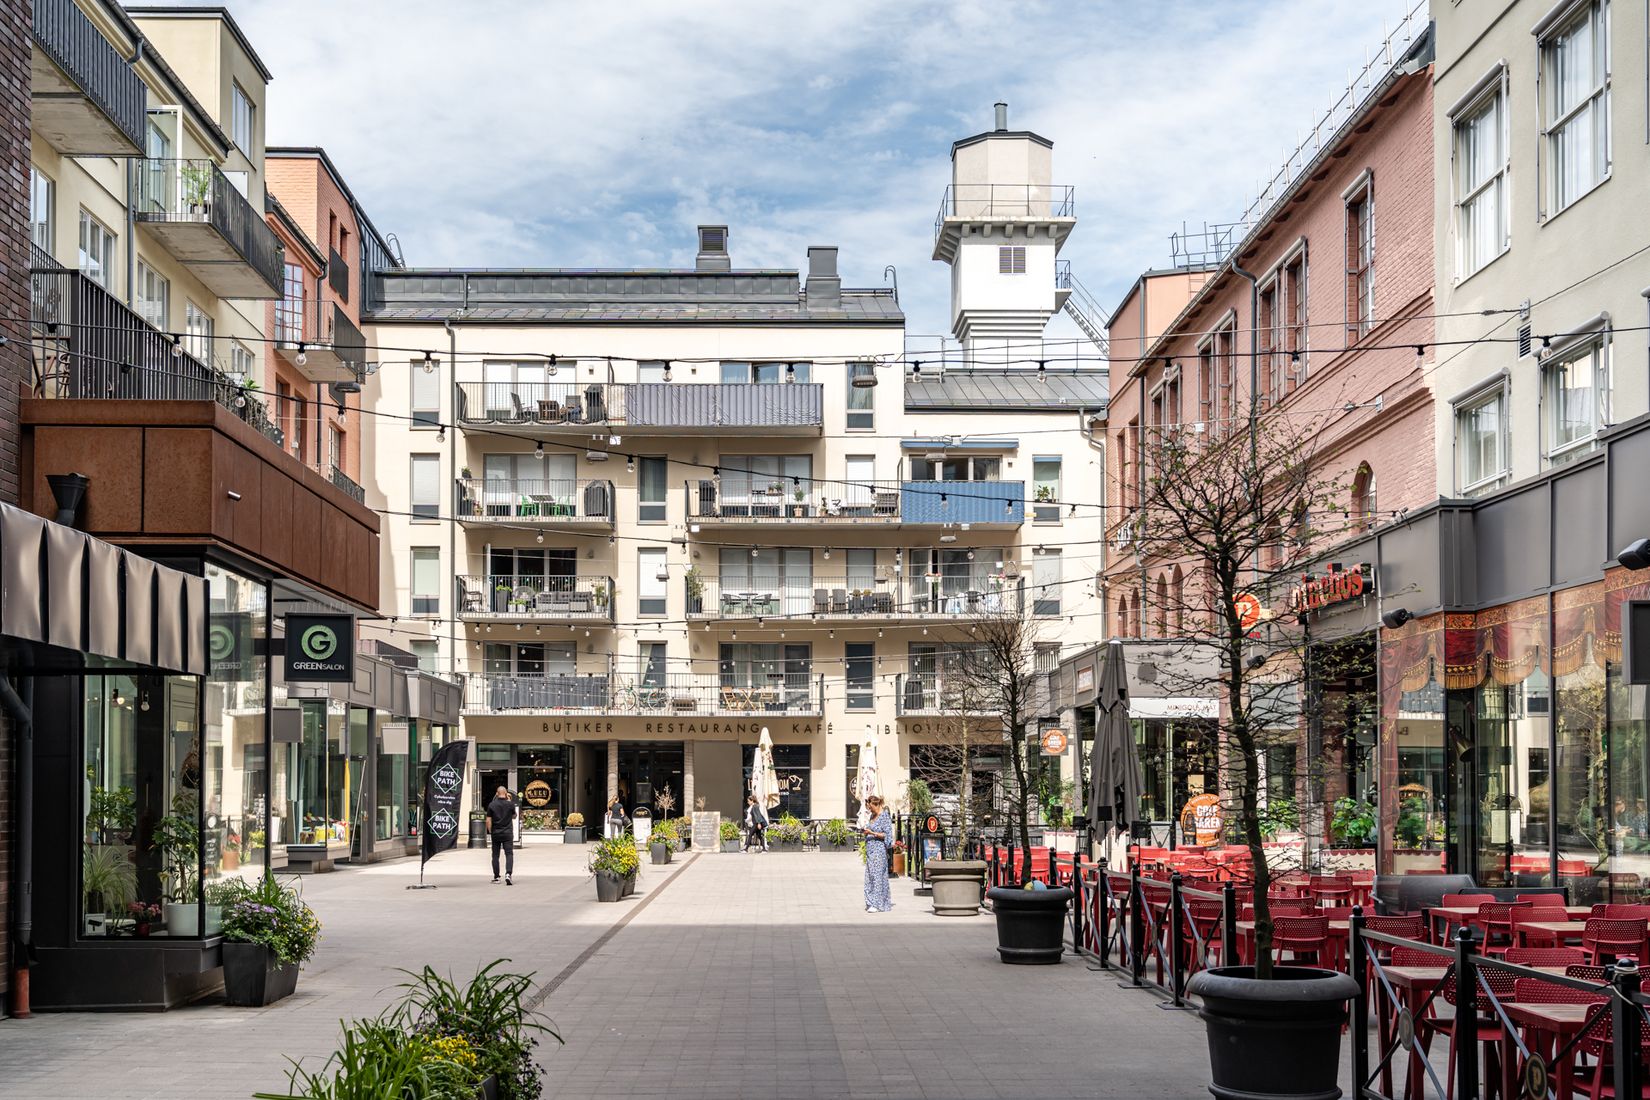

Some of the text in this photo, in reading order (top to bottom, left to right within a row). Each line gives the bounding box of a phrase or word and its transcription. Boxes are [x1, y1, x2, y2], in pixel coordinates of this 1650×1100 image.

[308, 631, 331, 654] G
[542, 722, 614, 733] BUTIKER
[646, 722, 760, 734] RESTAURANG
[792, 721, 834, 735] KAFÉ
[439, 770, 455, 779] BIKE
[437, 777, 456, 786] PATH
[434, 815, 450, 823] BIKE
[432, 822, 452, 831] PATH
